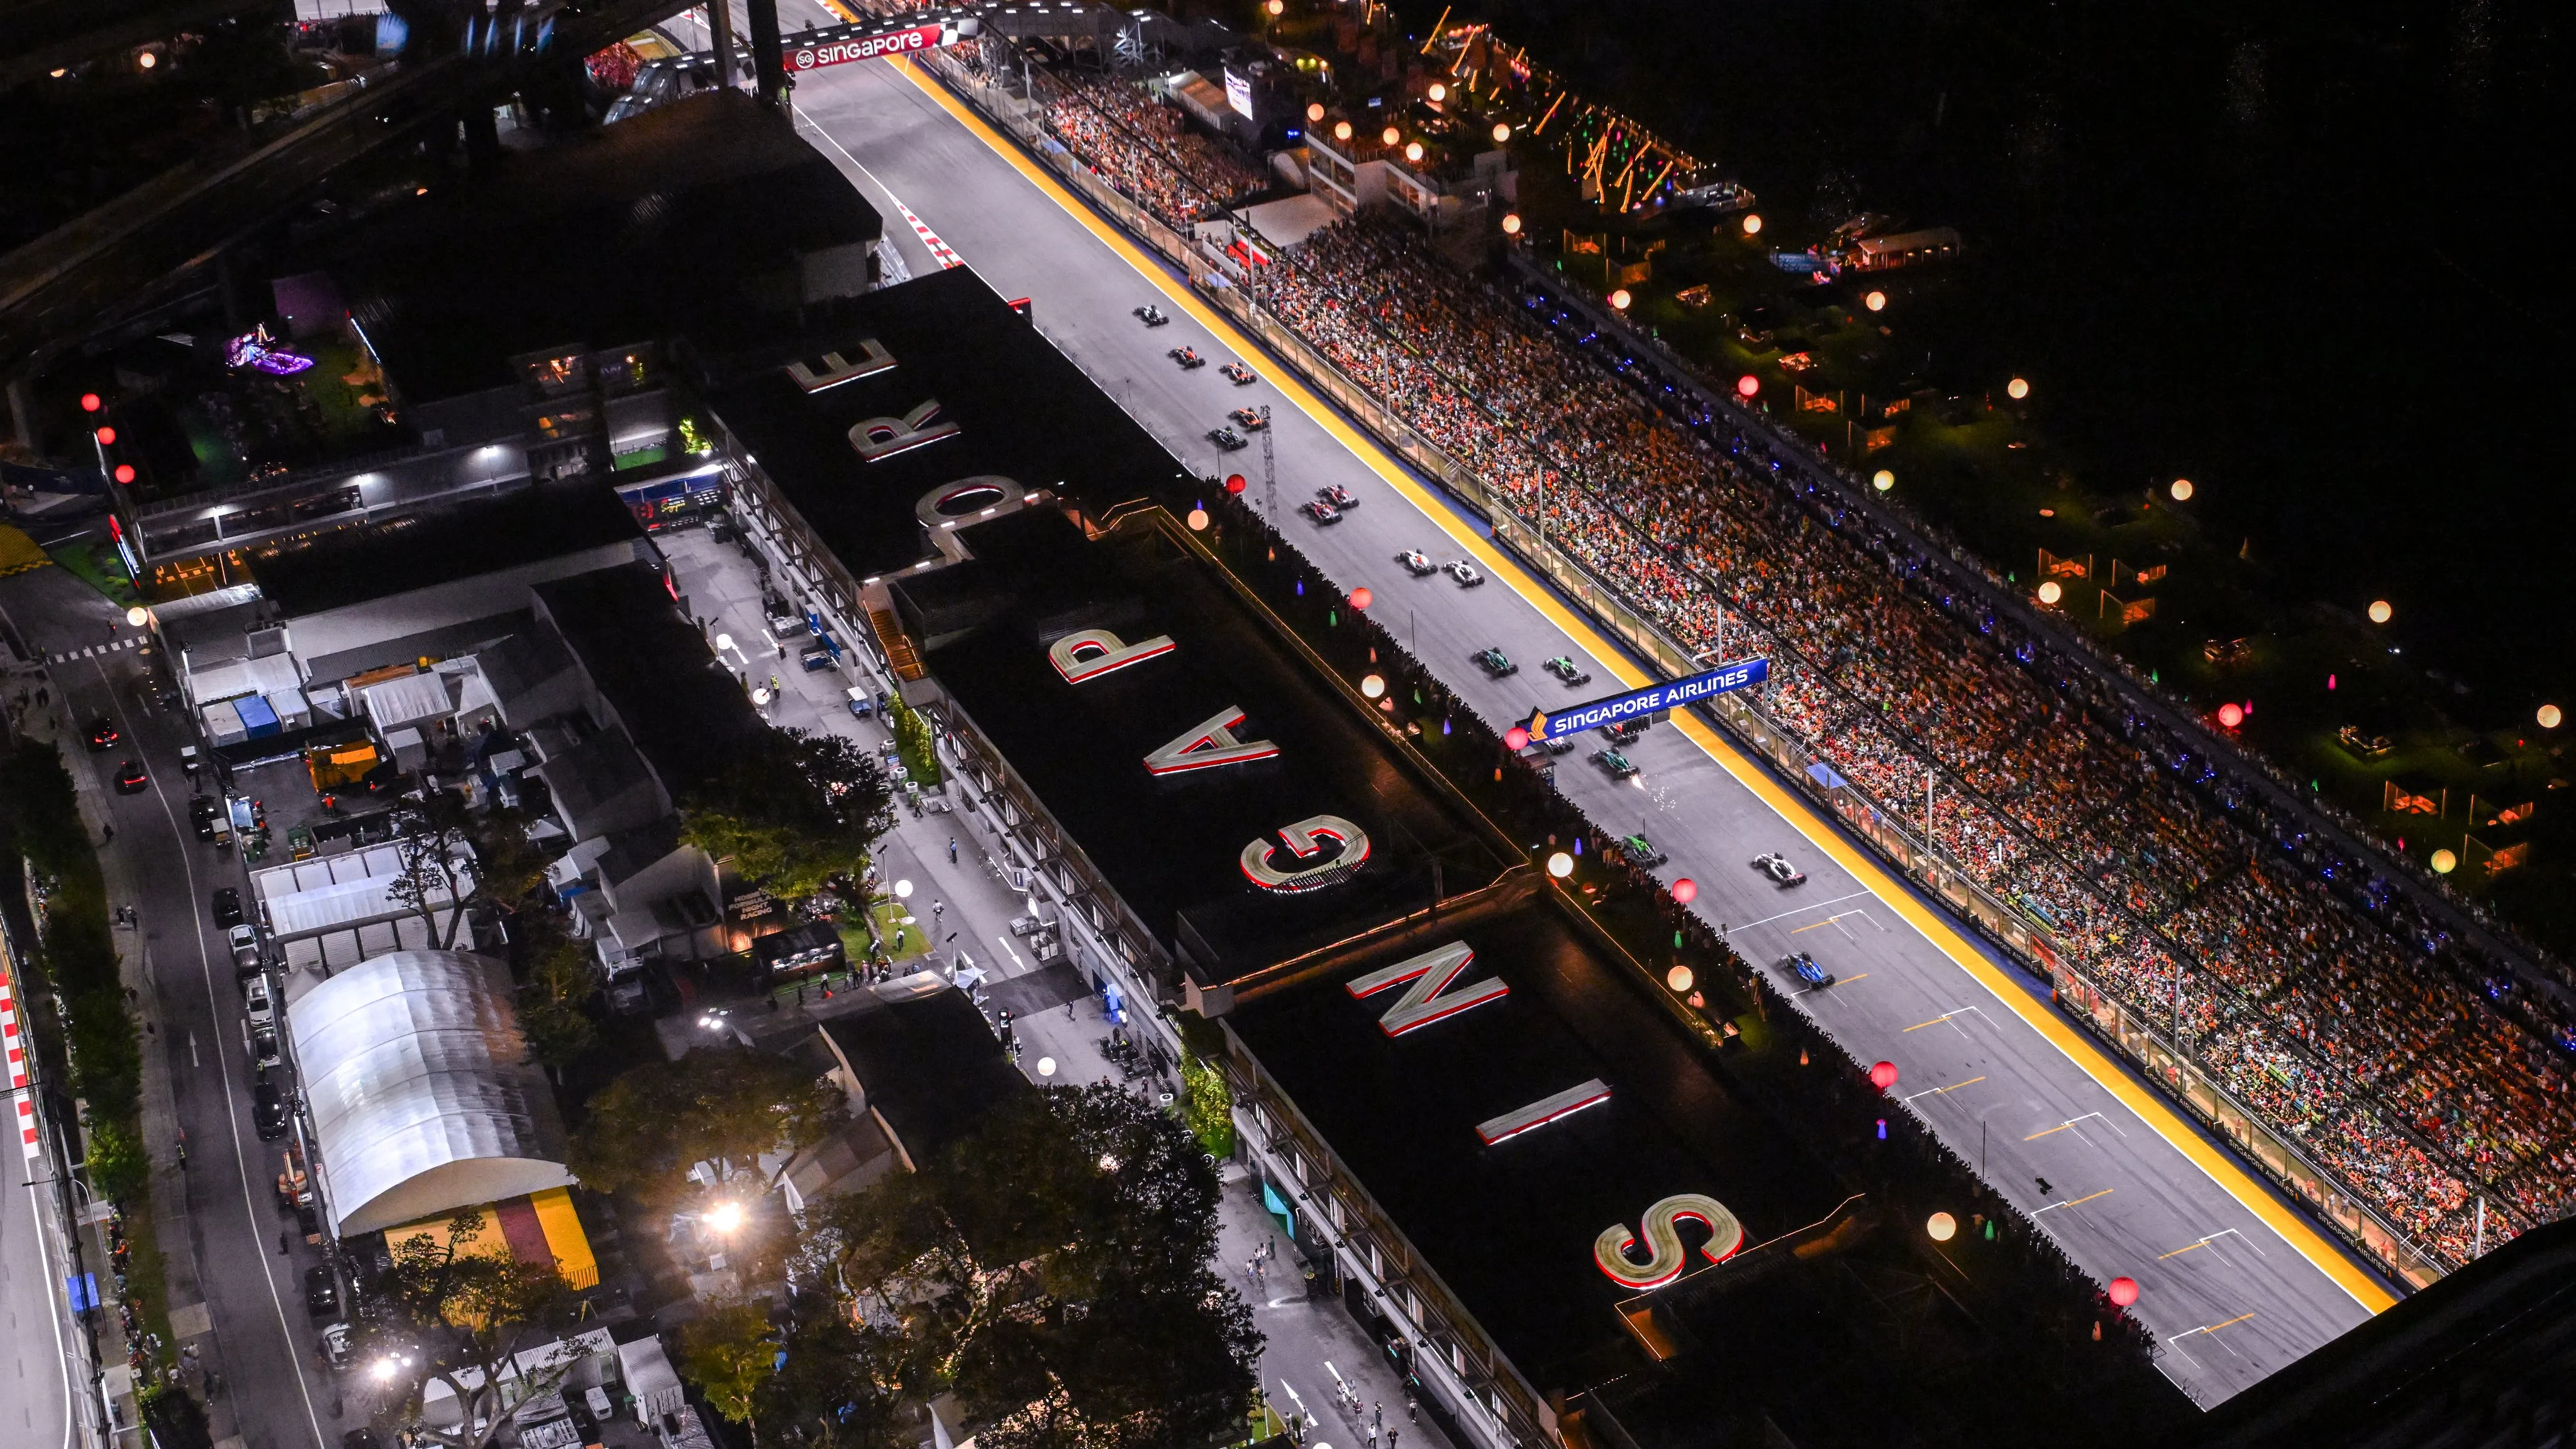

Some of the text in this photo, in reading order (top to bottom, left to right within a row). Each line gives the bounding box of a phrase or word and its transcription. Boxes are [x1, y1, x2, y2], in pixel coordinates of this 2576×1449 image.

[798, 55, 812, 64] SG
[1555, 669, 1748, 733] SINGAPORE AIRLINES
[1714, 713, 1758, 753] SINGAPORE AIRLINES
[1774, 763, 1821, 805] SINGAPORE AIRLINES
[1837, 815, 1886, 858] SINGAPORE AIRLINES
[1904, 870, 1958, 915] SGAPORE AIRLINES
[1979, 926, 2011, 954] SINGAPORE
[2097, 1029, 2123, 1055] AIRLINES
[2179, 1097, 2206, 1123] AIRLINES
[2228, 1138, 2264, 1172] SINGAPORE
[2318, 1212, 2387, 1273] SINGAPORE AIRLINES
